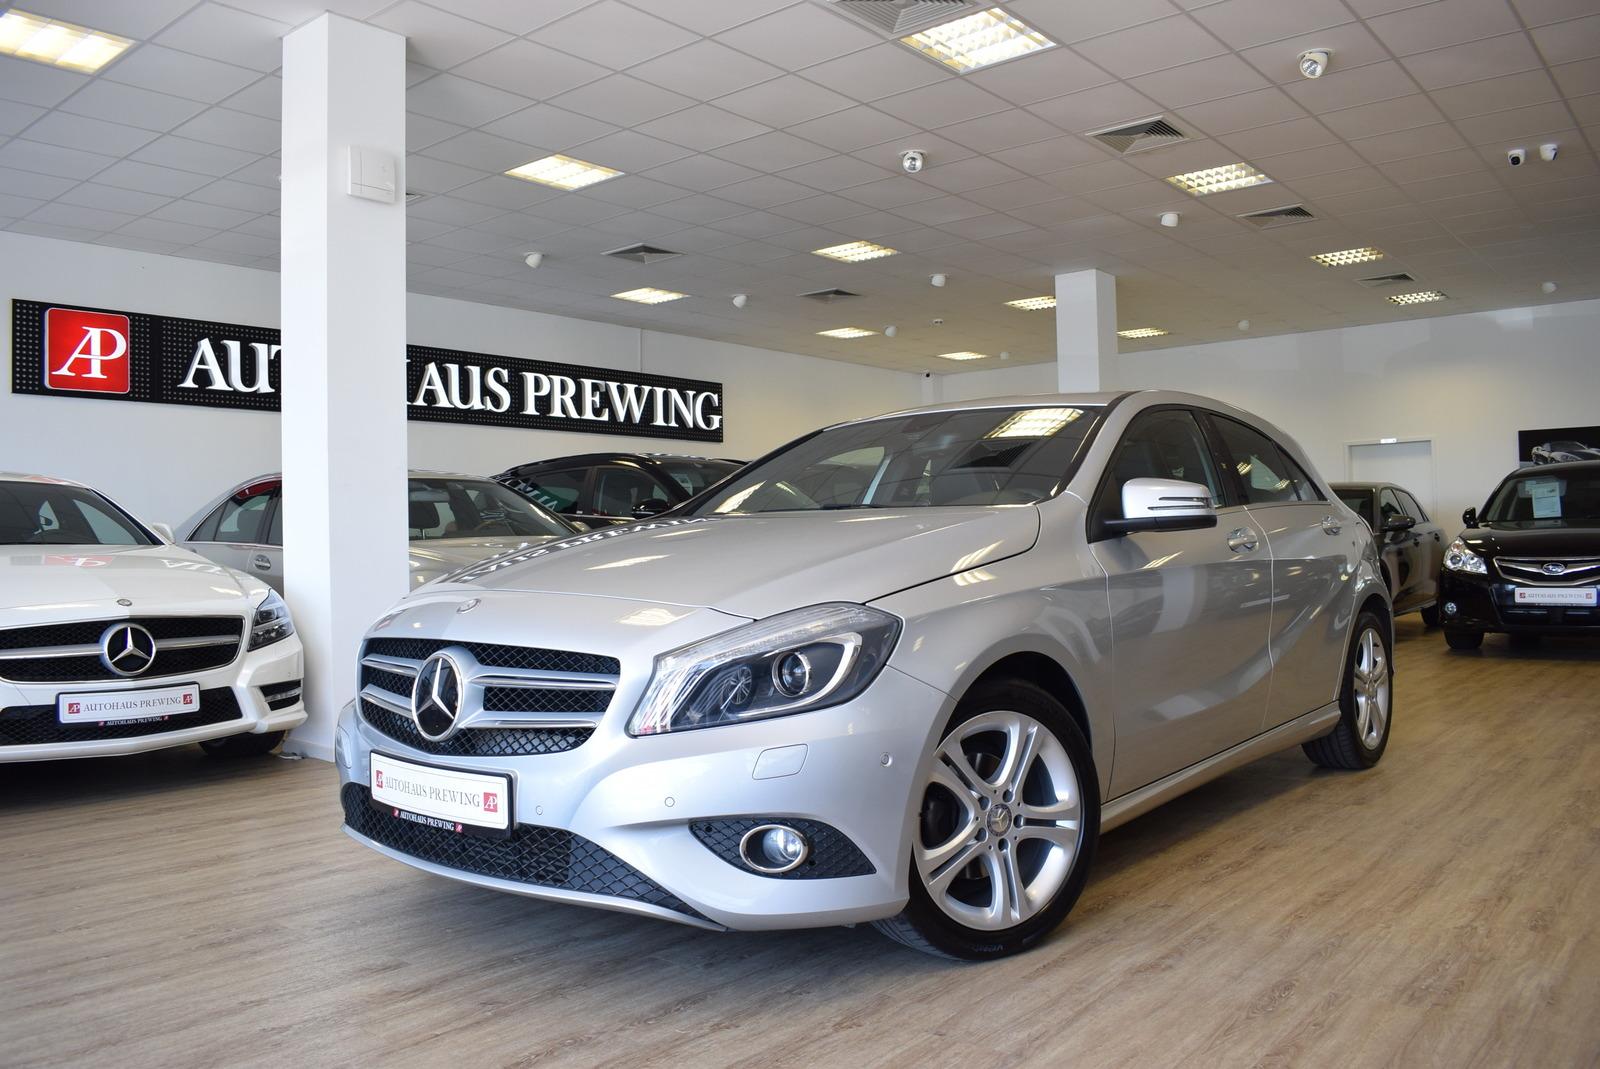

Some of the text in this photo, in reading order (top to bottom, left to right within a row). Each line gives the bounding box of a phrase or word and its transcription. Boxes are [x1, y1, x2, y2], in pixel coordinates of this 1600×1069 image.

[519, 371, 723, 430] PREWING
[83, 702, 138, 712] AUTOHAUS
[140, 696, 181, 708] PREWING
[385, 776, 427, 798] AUTOHAUS
[429, 786, 480, 808] PREWING
[399, 810, 427, 825] AUTOHAUS
[427, 817, 455, 831] PREWING
